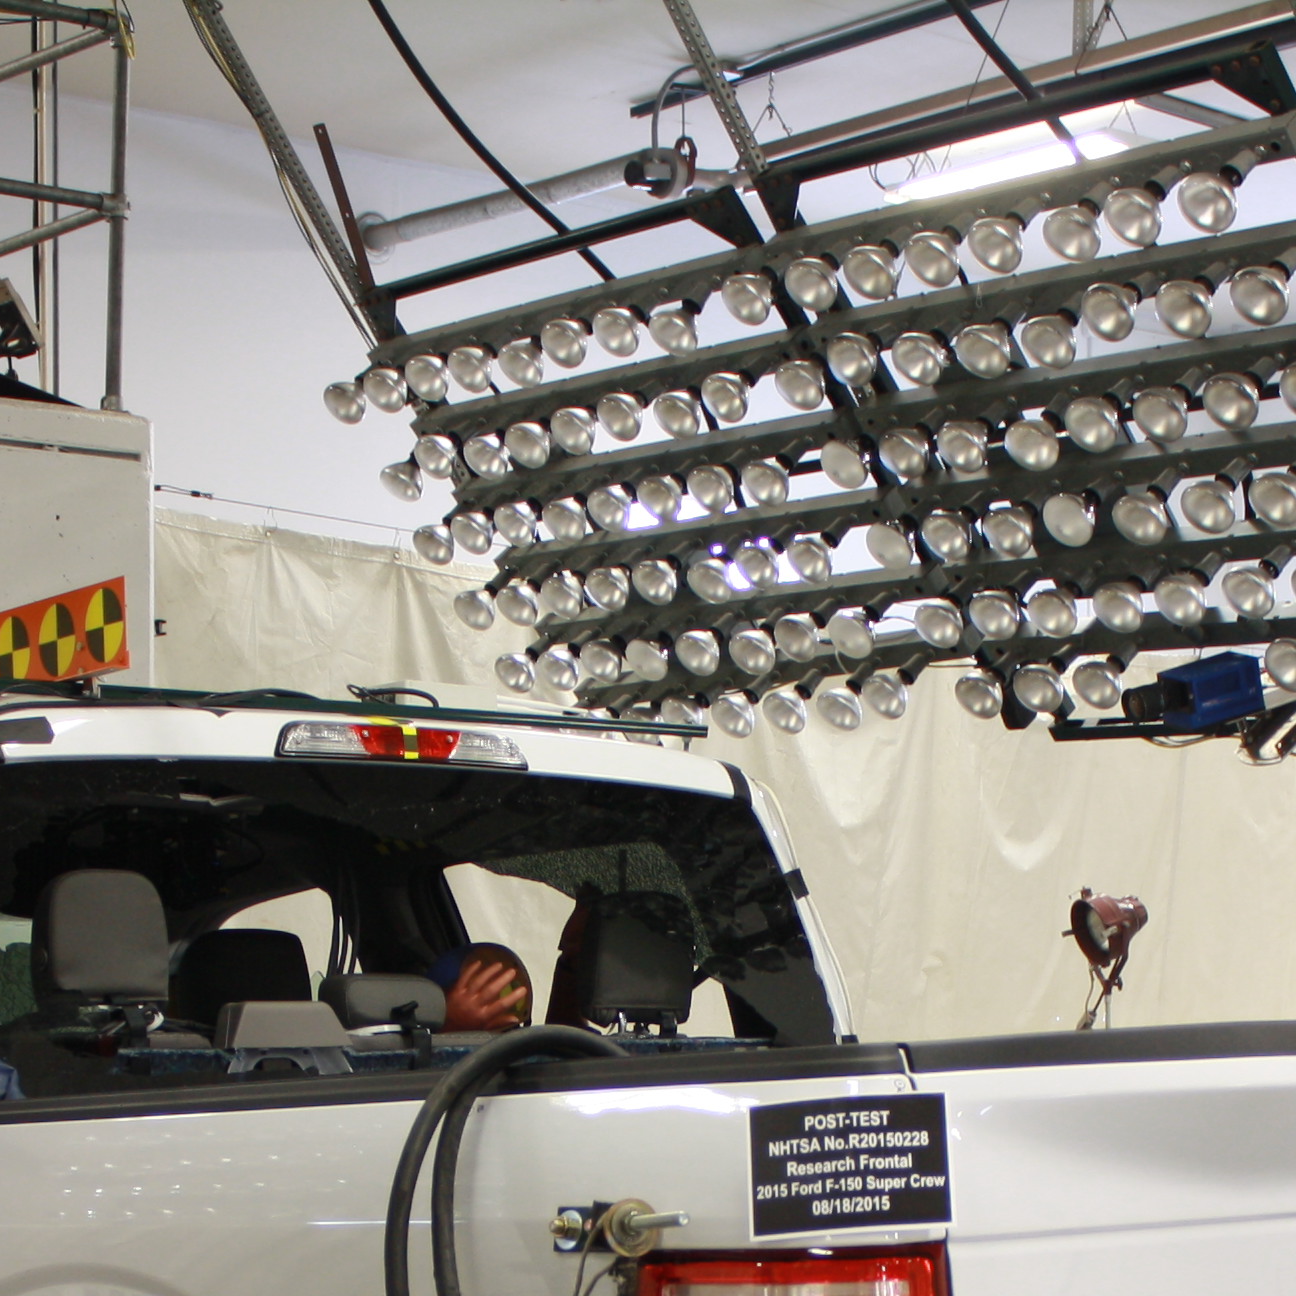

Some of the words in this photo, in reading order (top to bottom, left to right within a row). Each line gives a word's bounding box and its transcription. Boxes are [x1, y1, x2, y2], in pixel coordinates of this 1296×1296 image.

[804, 1110, 890, 1131] POST-TEST
[768, 1139, 822, 1157] NHTSA
[824, 1130, 930, 1151] No.R20150228
[787, 1156, 855, 1177] Research
[860, 1153, 912, 1171] Frontal
[757, 1184, 788, 1200] 2015
[791, 1181, 822, 1198] Ford
[826, 1177, 863, 1194] F-150
[866, 1175, 907, 1194] Super
[910, 1174, 945, 1188] Crew
[812, 1196, 891, 1216] 08/18/2015
